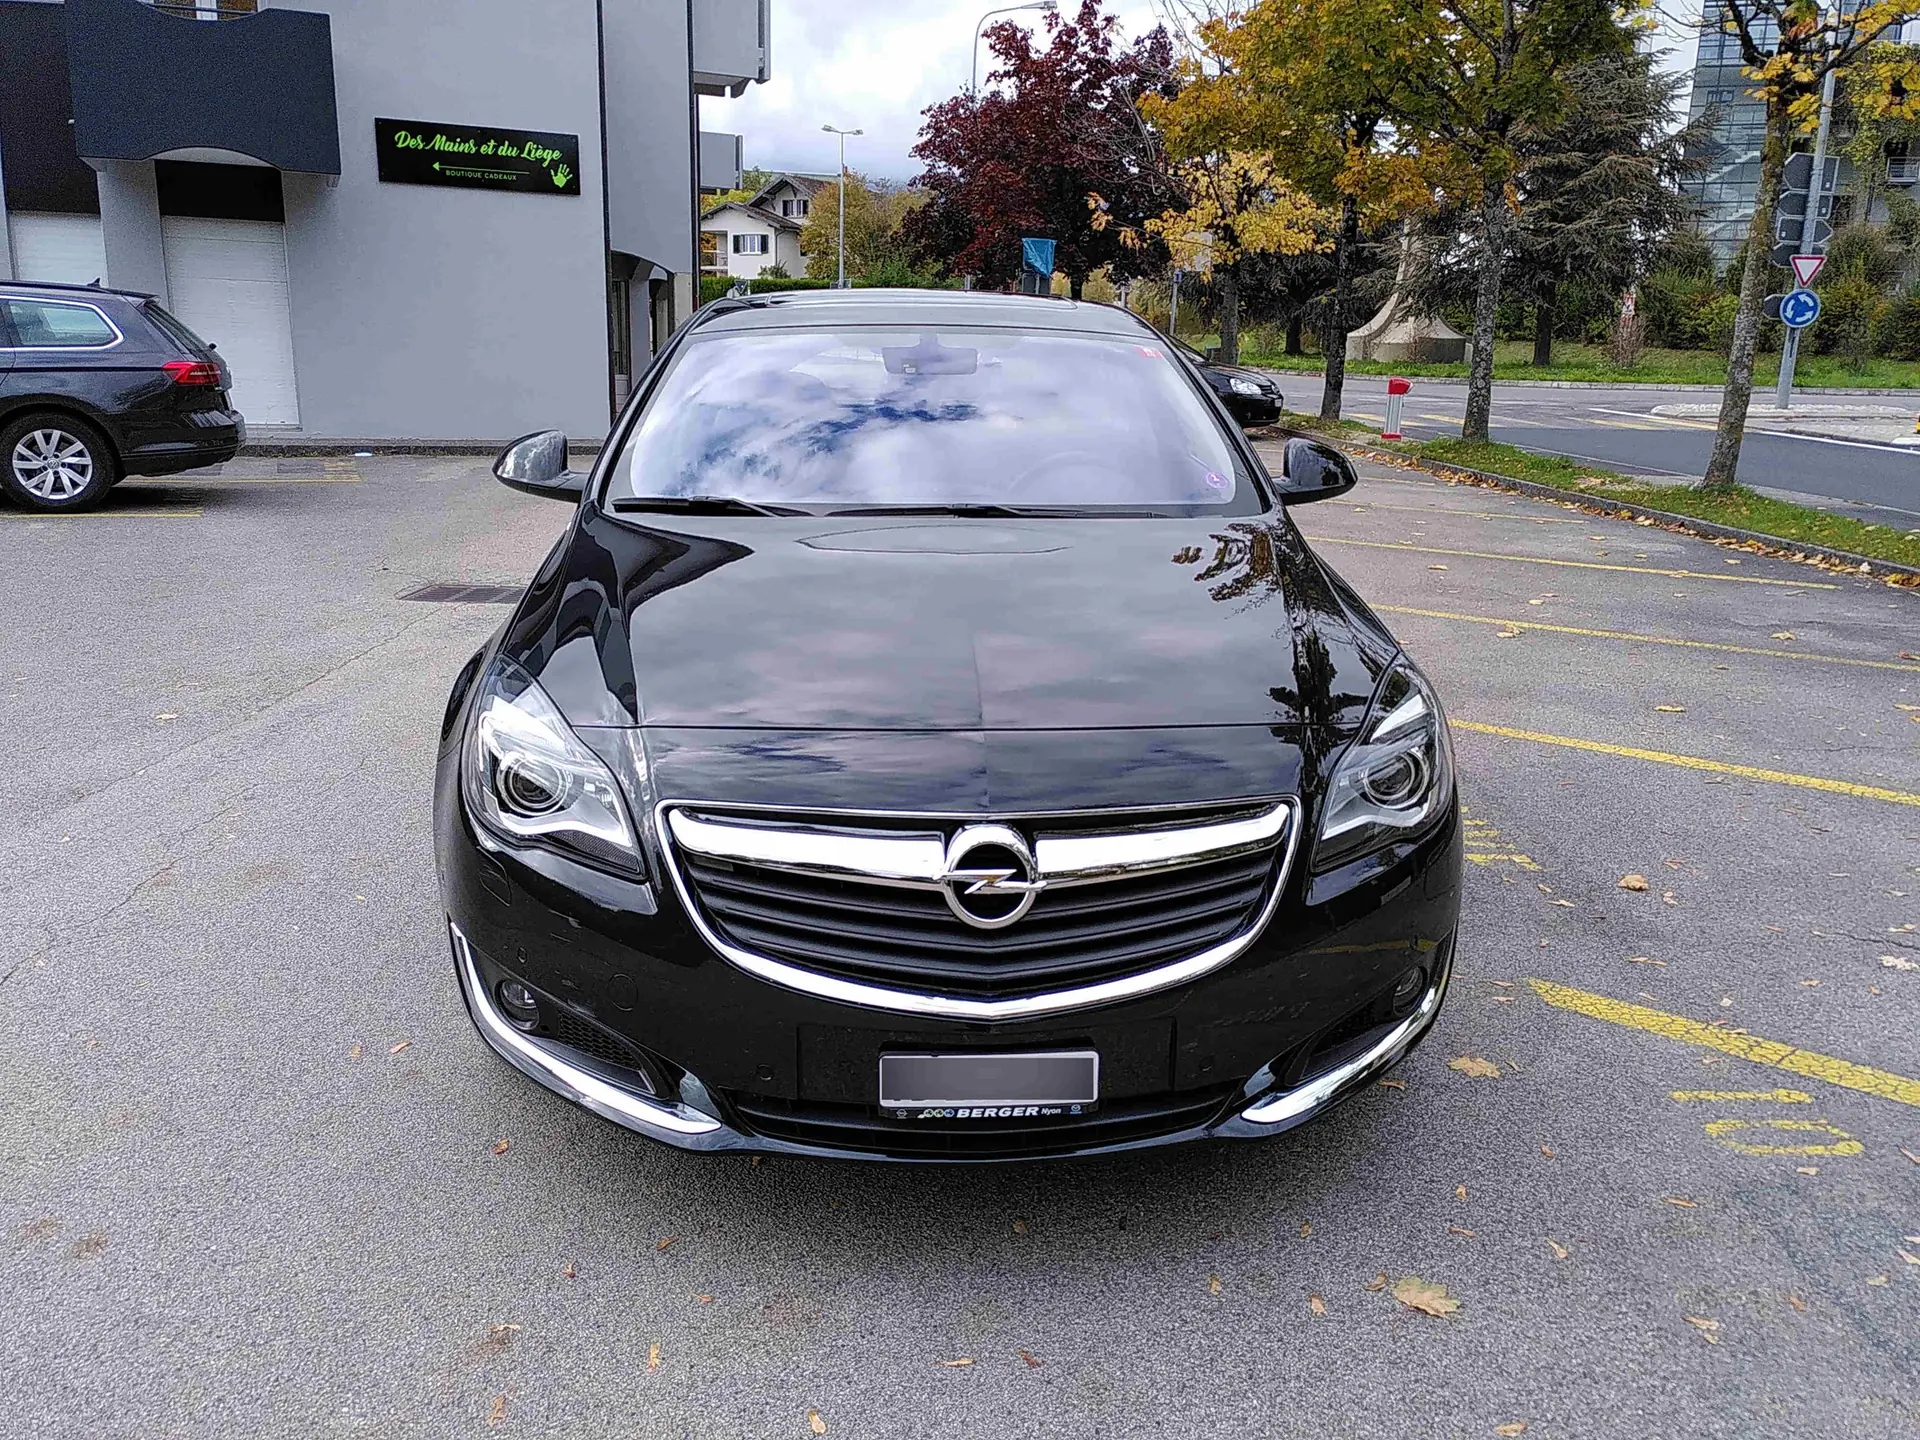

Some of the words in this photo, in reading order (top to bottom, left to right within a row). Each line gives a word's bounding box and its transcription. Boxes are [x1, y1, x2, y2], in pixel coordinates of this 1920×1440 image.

[394, 131, 426, 150] Des
[426, 133, 478, 154] Mains
[480, 139, 497, 155] et
[497, 140, 520, 157] du
[520, 142, 563, 168] Liège
[445, 170, 482, 179] BOUTIQUE
[484, 172, 517, 181] CADEAUX
[956, 1107, 1039, 1118] BERGER
